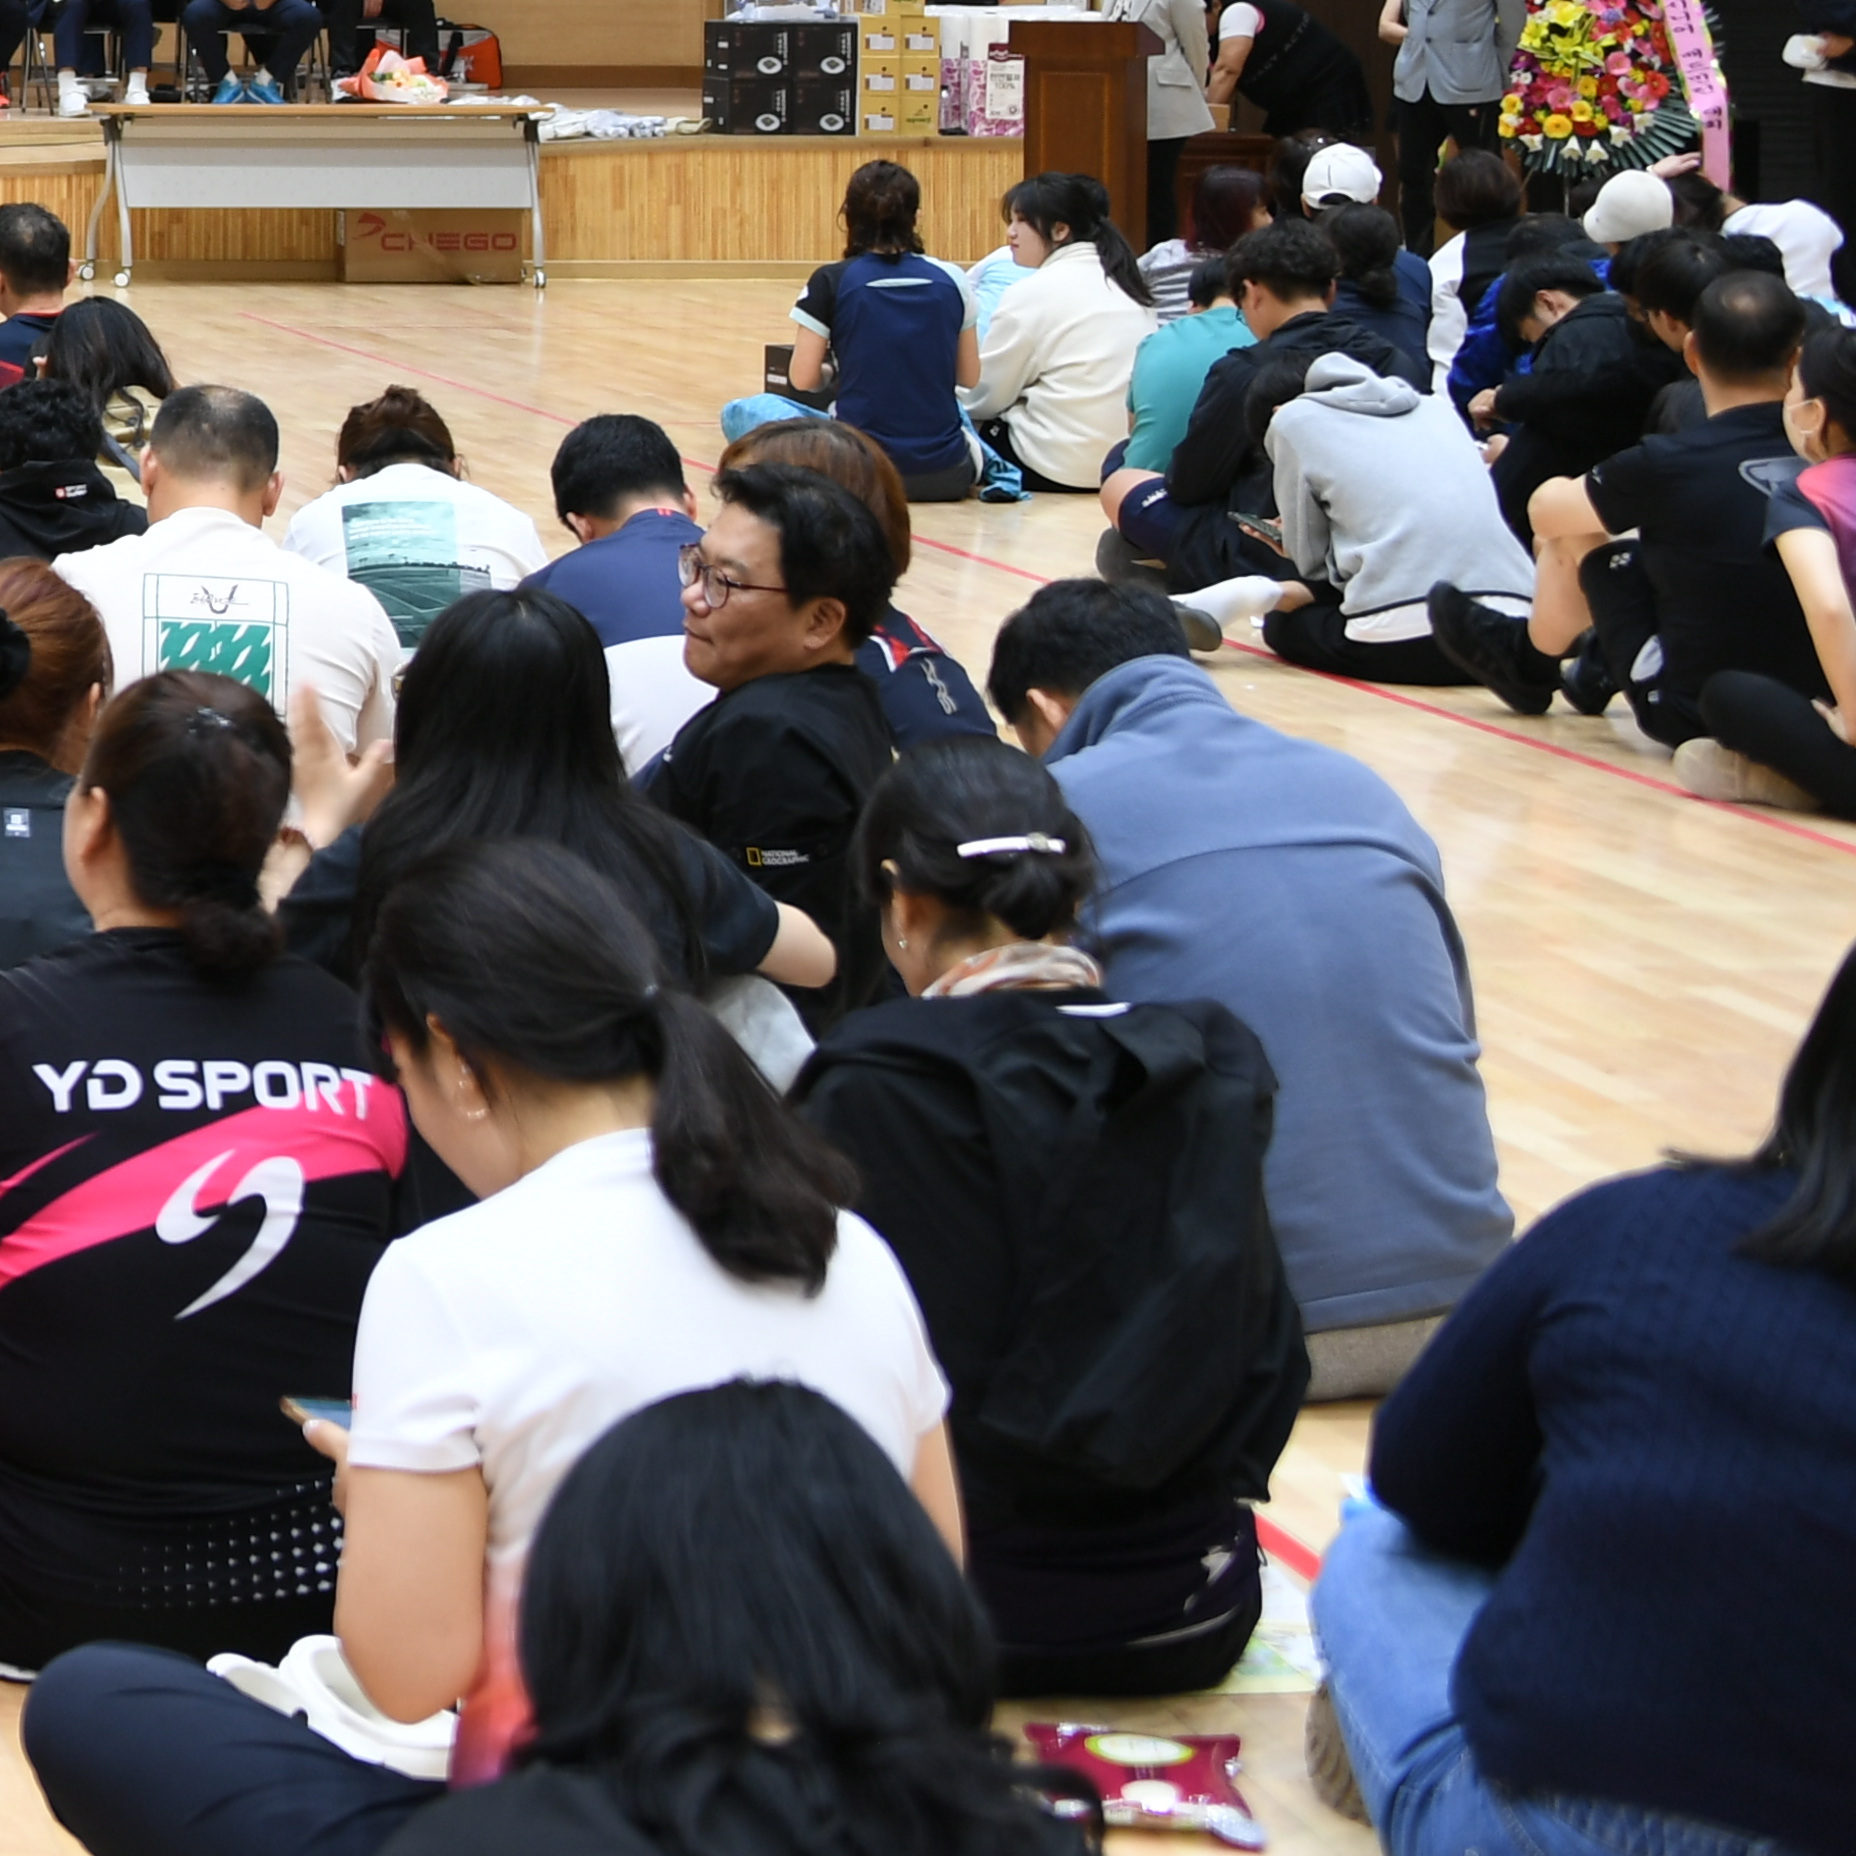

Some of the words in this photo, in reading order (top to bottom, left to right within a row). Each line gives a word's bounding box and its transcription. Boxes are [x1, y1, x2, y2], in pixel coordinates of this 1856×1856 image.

[379, 232, 518, 252] CHEGO
[32, 1060, 143, 1112] YD
[155, 1059, 374, 1120] SPORT
